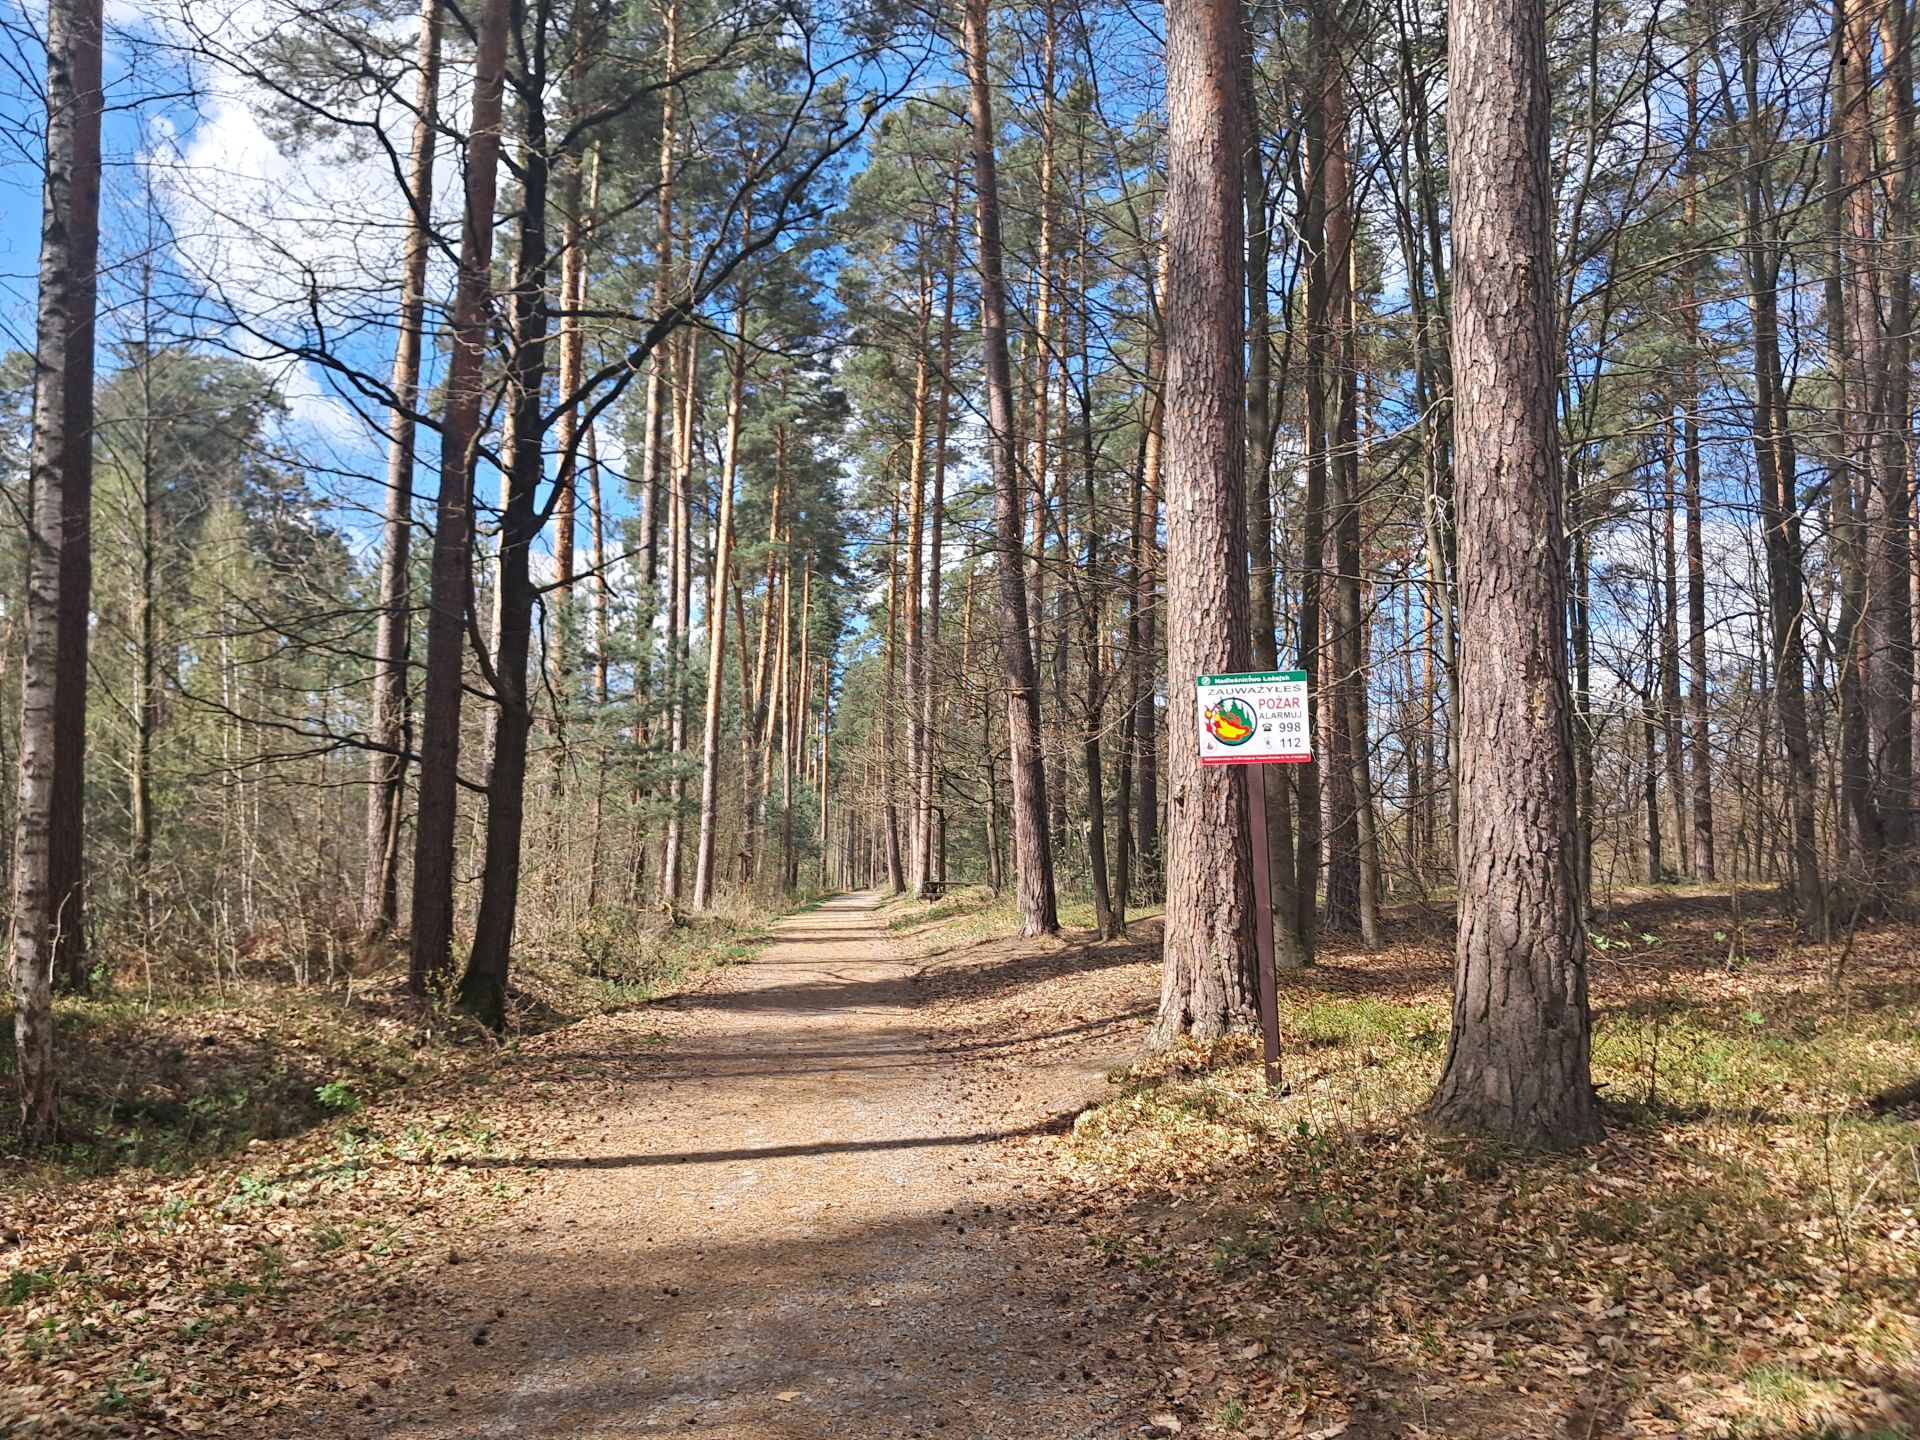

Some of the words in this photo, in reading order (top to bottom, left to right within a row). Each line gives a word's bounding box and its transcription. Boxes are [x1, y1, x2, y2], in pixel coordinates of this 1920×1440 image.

[1207, 684, 1301, 695] ZAUWAŻYŁEŚ
[1258, 695, 1300, 709] POŻAR
[1259, 711, 1302, 719] ALARMUJ
[1279, 723, 1301, 732] 998
[1280, 738, 1301, 748] 112
